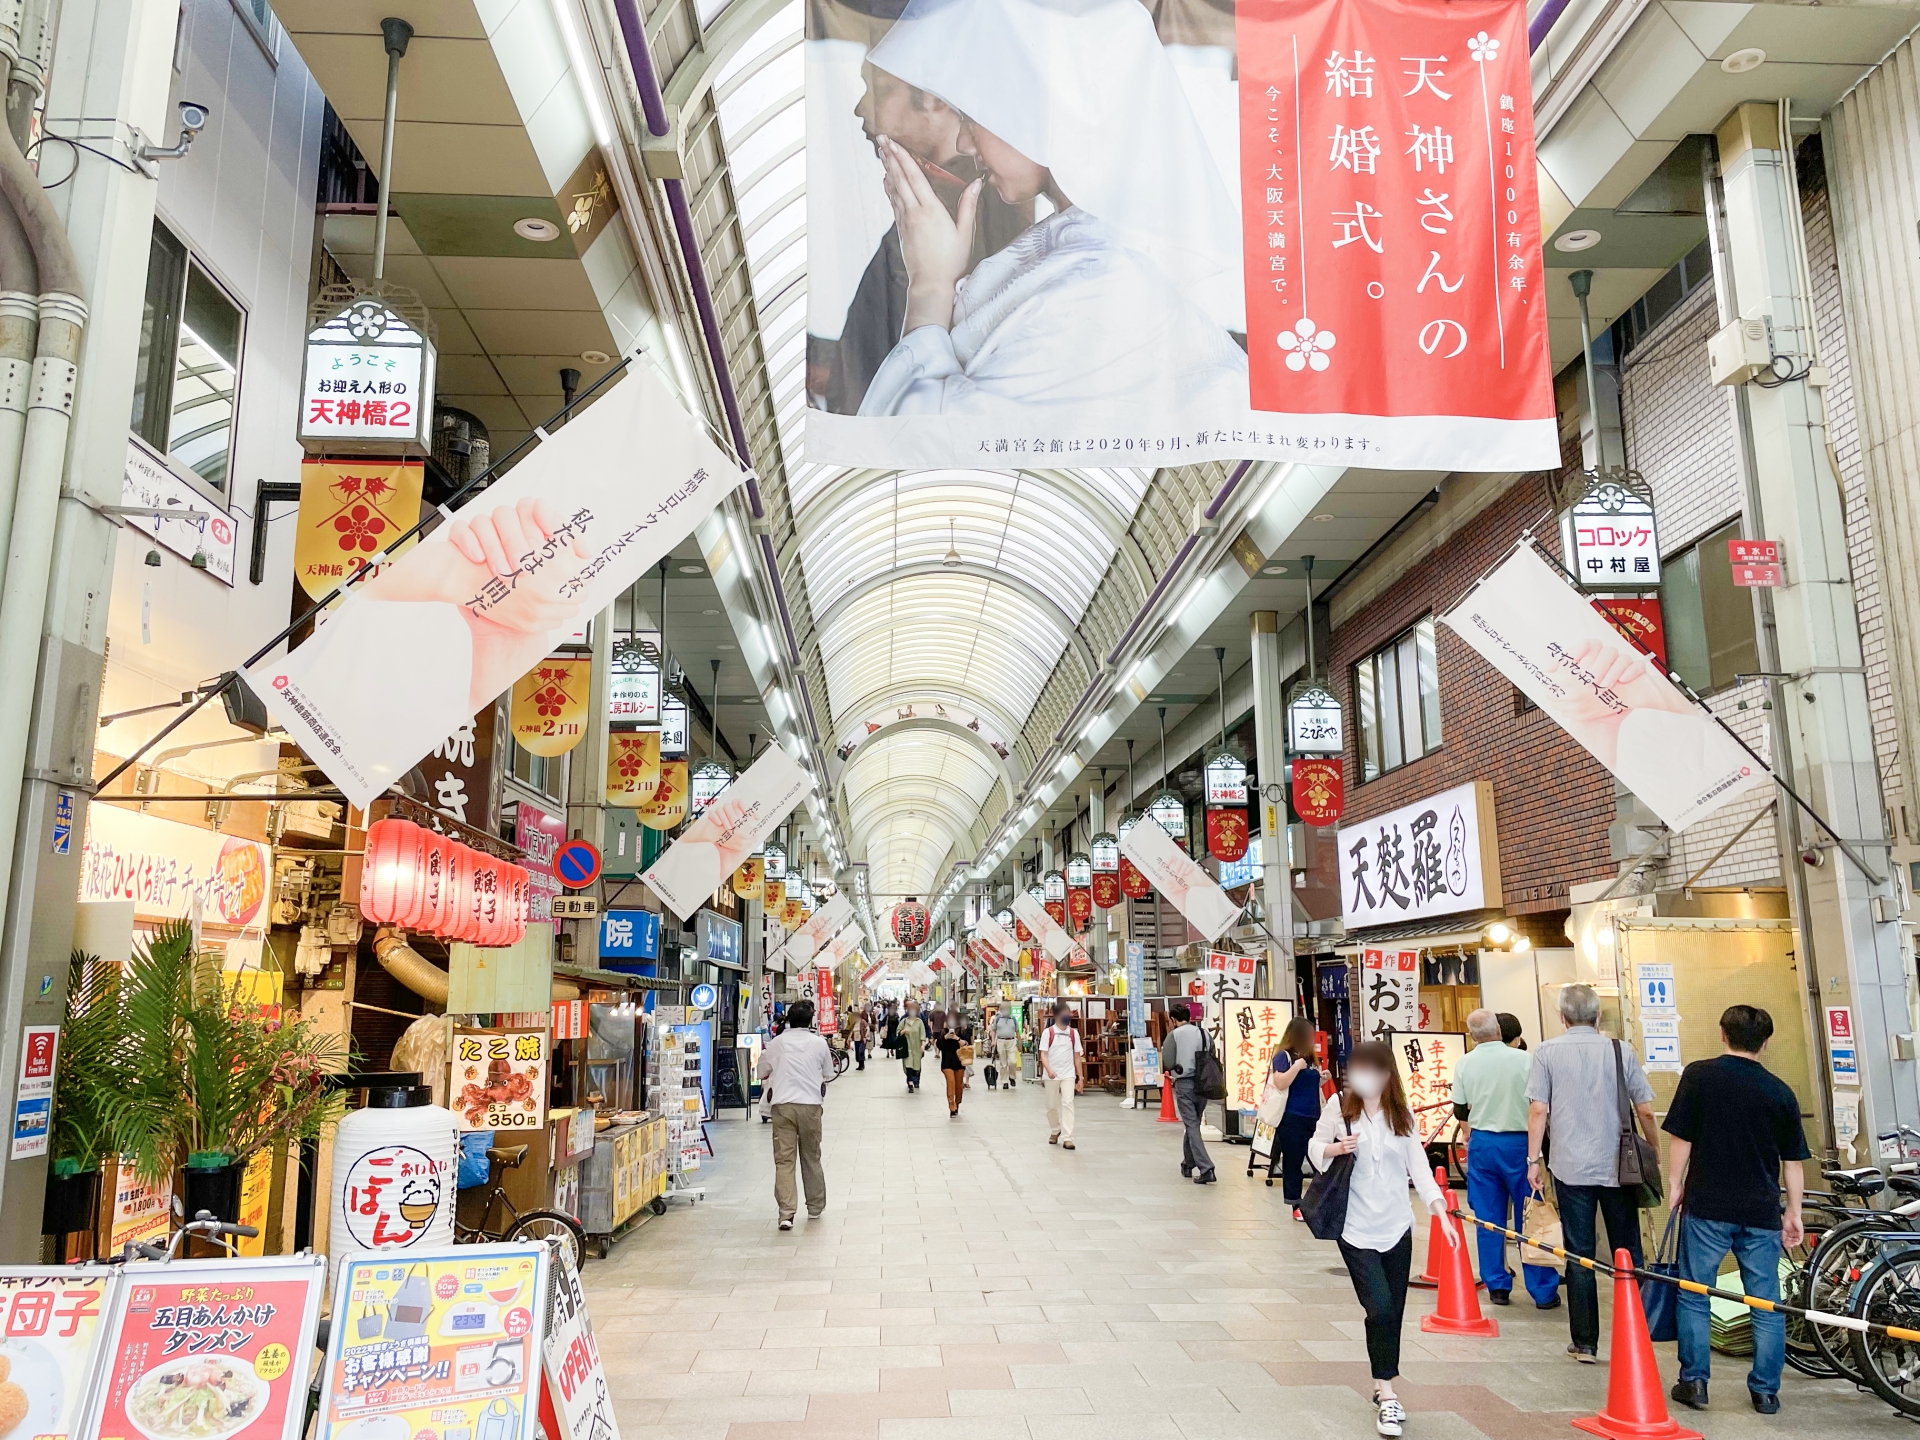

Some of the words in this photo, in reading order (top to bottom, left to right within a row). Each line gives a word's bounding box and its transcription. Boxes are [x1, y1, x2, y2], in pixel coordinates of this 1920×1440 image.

[1323, 49, 1386, 300] 結婚式。
[1263, 85, 1289, 306] 今こそ、大阪天満宮で。
[1399, 54, 1469, 360] 天神さんの
[1498, 93, 1529, 306] 鎮座1000有余年、
[331, 353, 397, 373] ようこそ
[317, 378, 407, 395] お迎え人形の
[308, 397, 411, 427] 天神橋2
[977, 428, 1384, 454] 天満宮会館は2020年9月、新たに生まれ変わります。
[558, 467, 710, 598] 新型コロナウイルスに負けない
[1577, 526, 1652, 547] コロッケ
[464, 505, 596, 618] 私たちは人間だ
[1587, 557, 1651, 573] 中村屋
[610, 701, 655, 715] 工房エルシー
[612, 691, 649, 699] 手作りの店
[280, 688, 342, 756] 天神橋筋商店連合会
[517, 719, 579, 737] 天神橋2丁目
[605, 779, 653, 793] 天神橋2丁目
[1211, 789, 1245, 800] 天神橋2
[639, 804, 683, 816] 天神橋2丁目
[86, 842, 177, 908] 浪花ひとくち餃子
[1349, 809, 1448, 914] 天麩羅
[484, 869, 498, 924] 餃子
[553, 901, 596, 914] 自動車
[605, 918, 633, 948] 院
[1212, 956, 1251, 971] 手作り
[1365, 951, 1412, 969] 手作り
[459, 1035, 541, 1062] たこ焼
[1236, 1038, 1256, 1105] 食べ放題
[488, 1104, 507, 1112] 8コ
[488, 1113, 537, 1127] 350円
[400, 1160, 448, 1178] おいしい
[350, 1149, 413, 1247] ごはん
[179, 1286, 254, 1304] 野菜たっぷり
[0, 1290, 101, 1338] 団子
[150, 1303, 276, 1330] 五目あんかけ
[508, 1311, 528, 1326] 5%
[162, 1327, 254, 1356] タンメン
[344, 1346, 430, 1375] お客様感謝
[342, 1360, 451, 1392] キャンペーン!!
